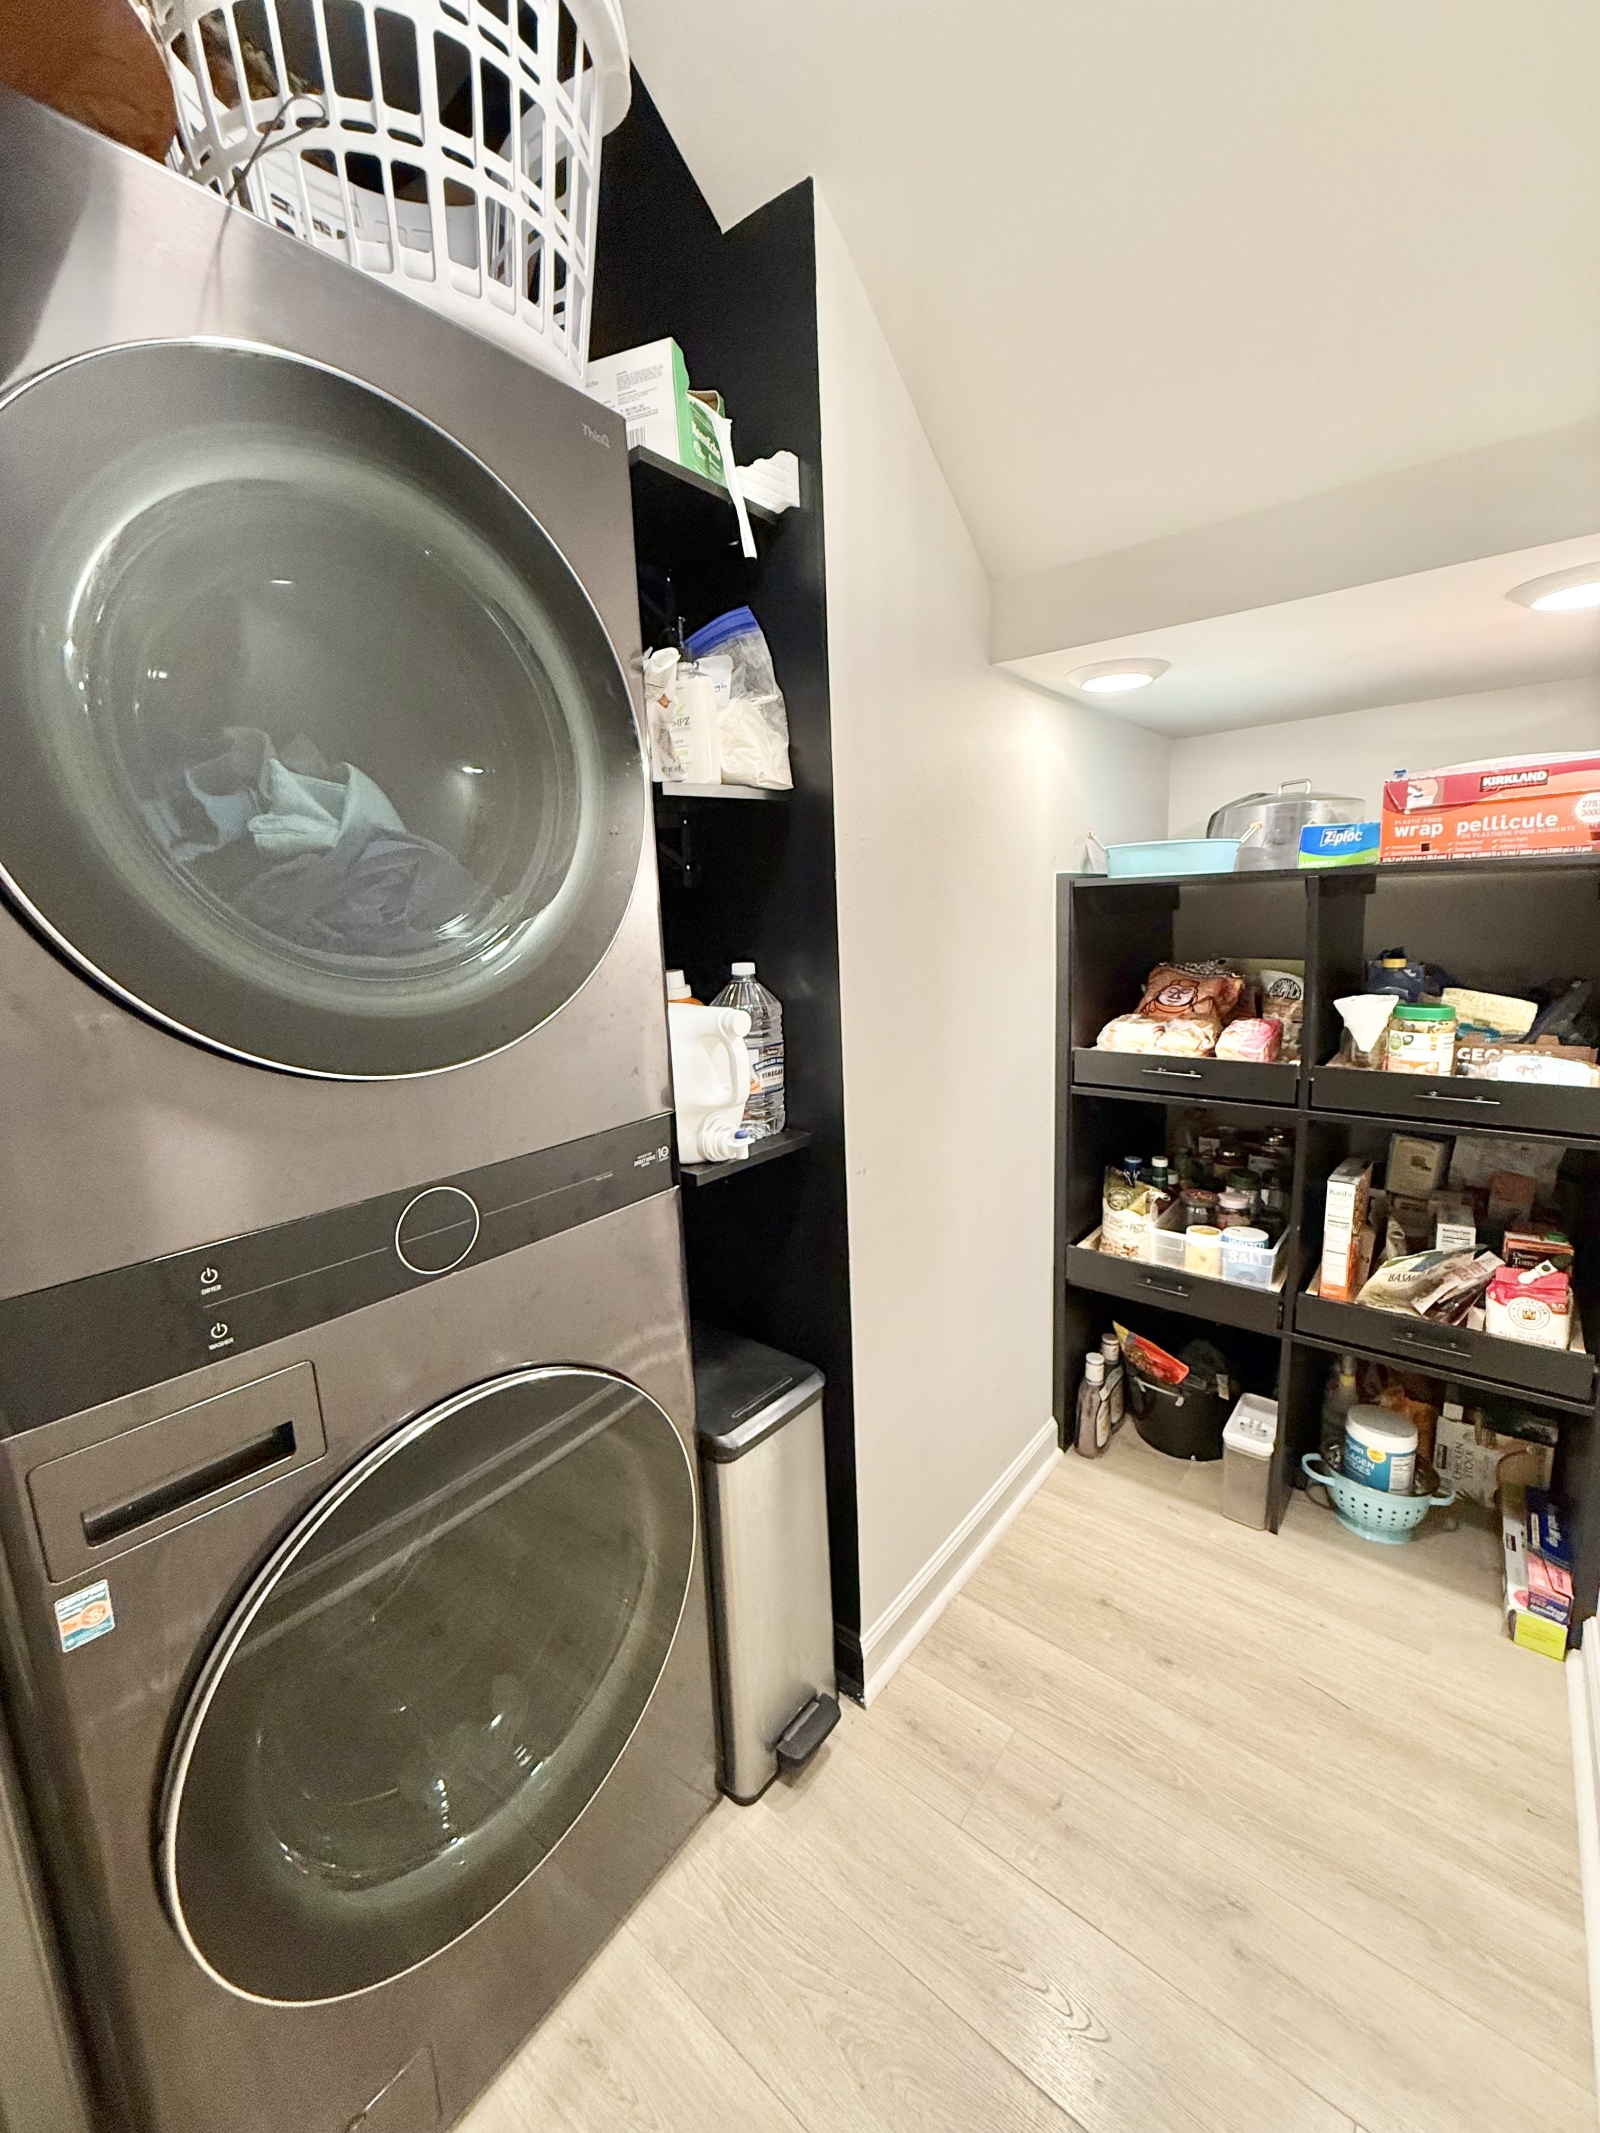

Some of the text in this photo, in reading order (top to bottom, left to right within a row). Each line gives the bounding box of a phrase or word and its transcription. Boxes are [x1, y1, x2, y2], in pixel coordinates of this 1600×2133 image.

[582, 422, 610, 449] ThinQ
[1482, 770, 1548, 787] KIRKLAND
[1394, 823, 1444, 838] wrap
[1456, 812, 1558, 836] pellicule
[1472, 829, 1512, 838] PLASTIQUE
[1537, 825, 1576, 833] ALIMENTS
[1324, 830, 1364, 847] Ziploc
[658, 1146, 669, 1160] 10
